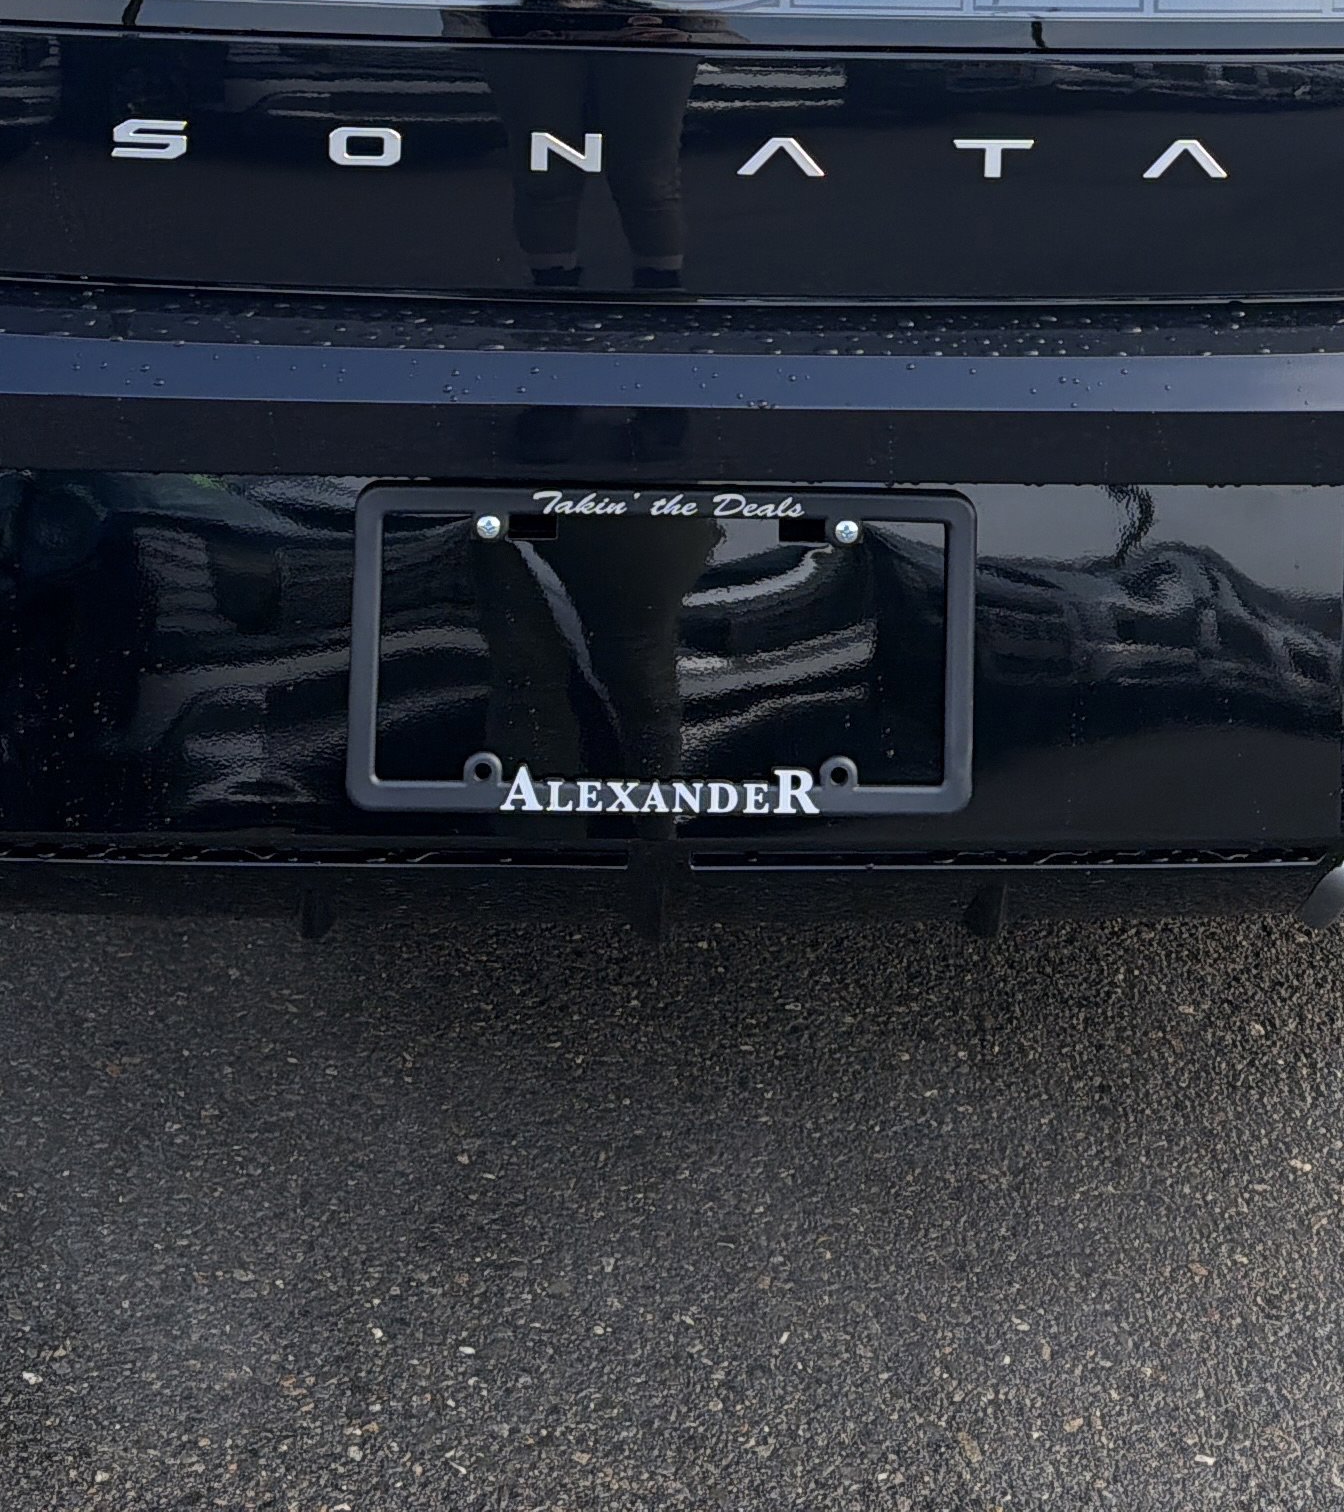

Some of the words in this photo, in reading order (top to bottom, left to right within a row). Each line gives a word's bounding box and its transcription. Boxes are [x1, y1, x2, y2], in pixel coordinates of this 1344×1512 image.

[110, 119, 1228, 179] SONATA
[532, 490, 641, 515] Takin'
[650, 493, 698, 517] the
[712, 493, 805, 518] Deals
[500, 766, 820, 814] ALEXANDER
